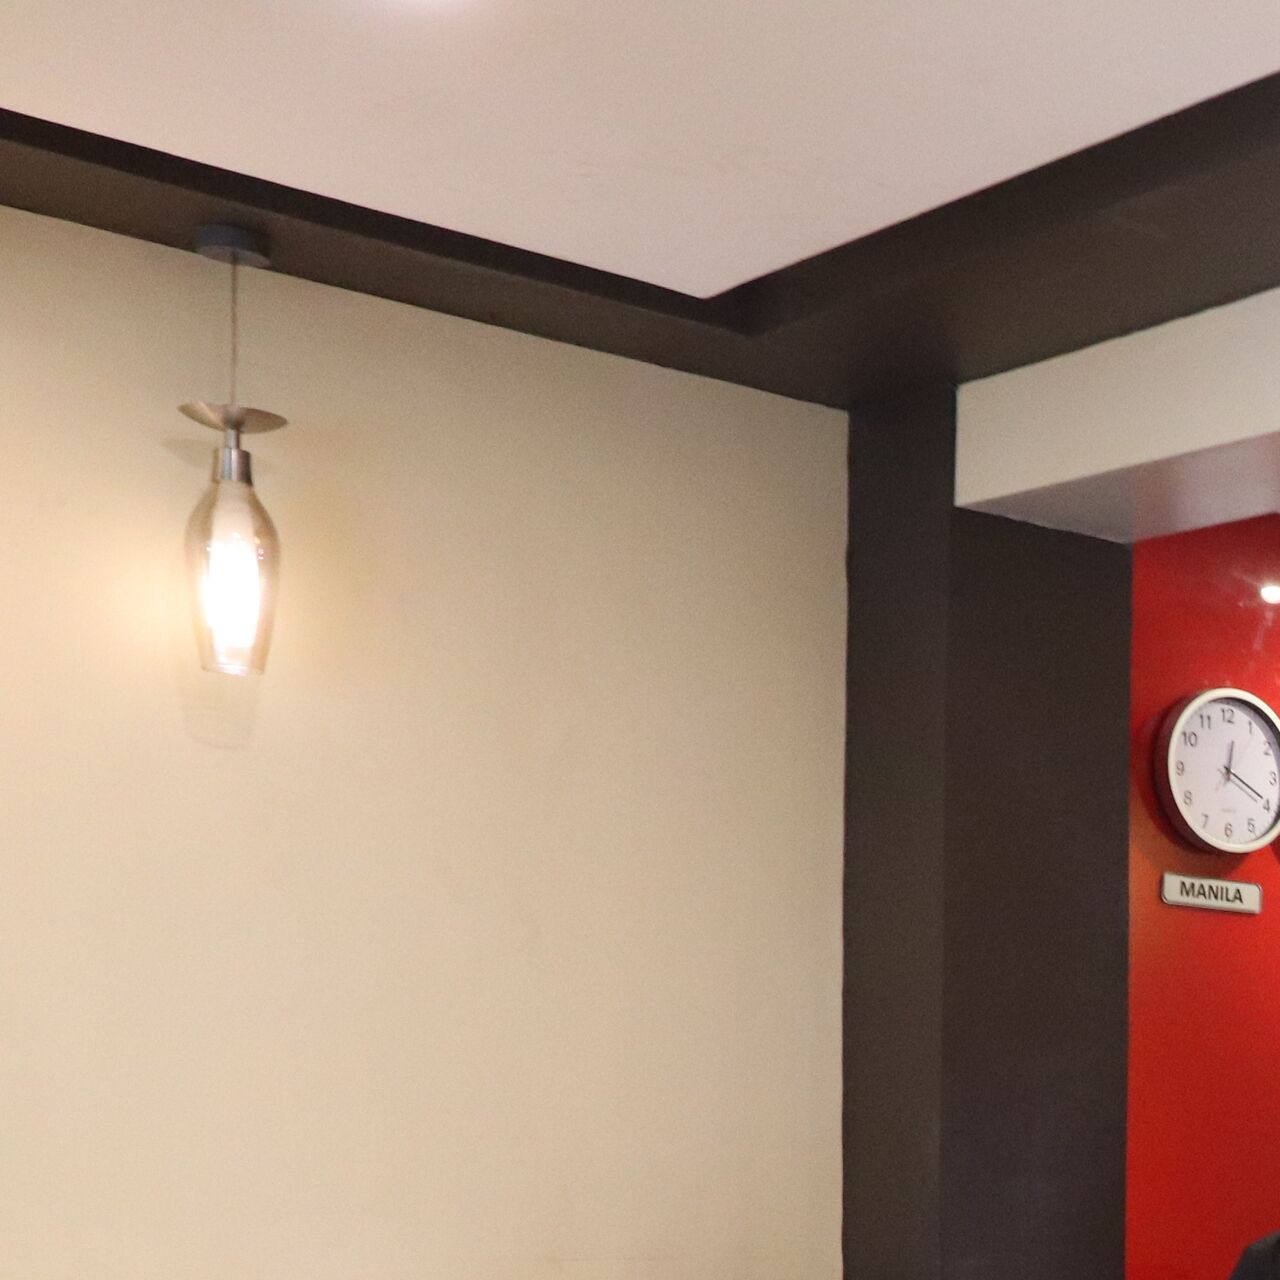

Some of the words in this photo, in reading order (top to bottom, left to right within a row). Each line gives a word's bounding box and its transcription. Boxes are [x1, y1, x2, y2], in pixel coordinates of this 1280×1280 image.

[1200, 714, 1212, 729] 11
[1221, 708, 1234, 724] 12
[1182, 731, 1198, 747] 10
[1264, 741, 1272, 756] 2
[1176, 760, 1185, 776] 9
[1269, 771, 1277, 786] 3
[1183, 790, 1192, 806] 8
[1263, 798, 1271, 813] 4
[1201, 813, 1209, 829] 7
[1247, 818, 1255, 833] 5
[1224, 823, 1233, 838] 6
[1180, 880, 1244, 904] MANILA
